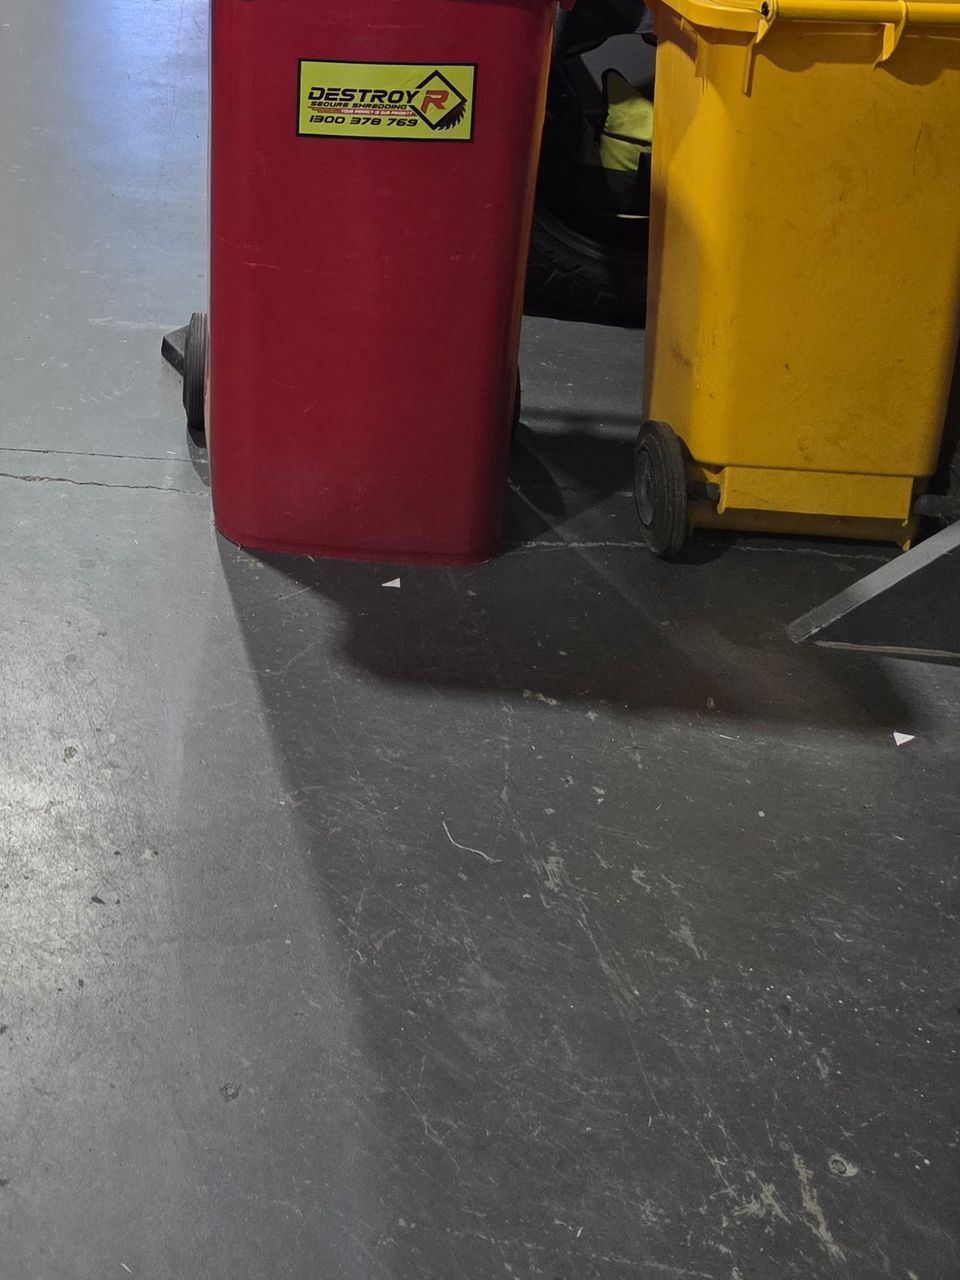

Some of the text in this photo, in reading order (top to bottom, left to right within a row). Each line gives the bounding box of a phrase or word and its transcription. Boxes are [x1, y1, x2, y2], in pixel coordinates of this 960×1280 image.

[308, 86, 420, 104] DESTROY
[352, 102, 407, 110] SHREDDING
[309, 115, 419, 127] 1300 378 769
